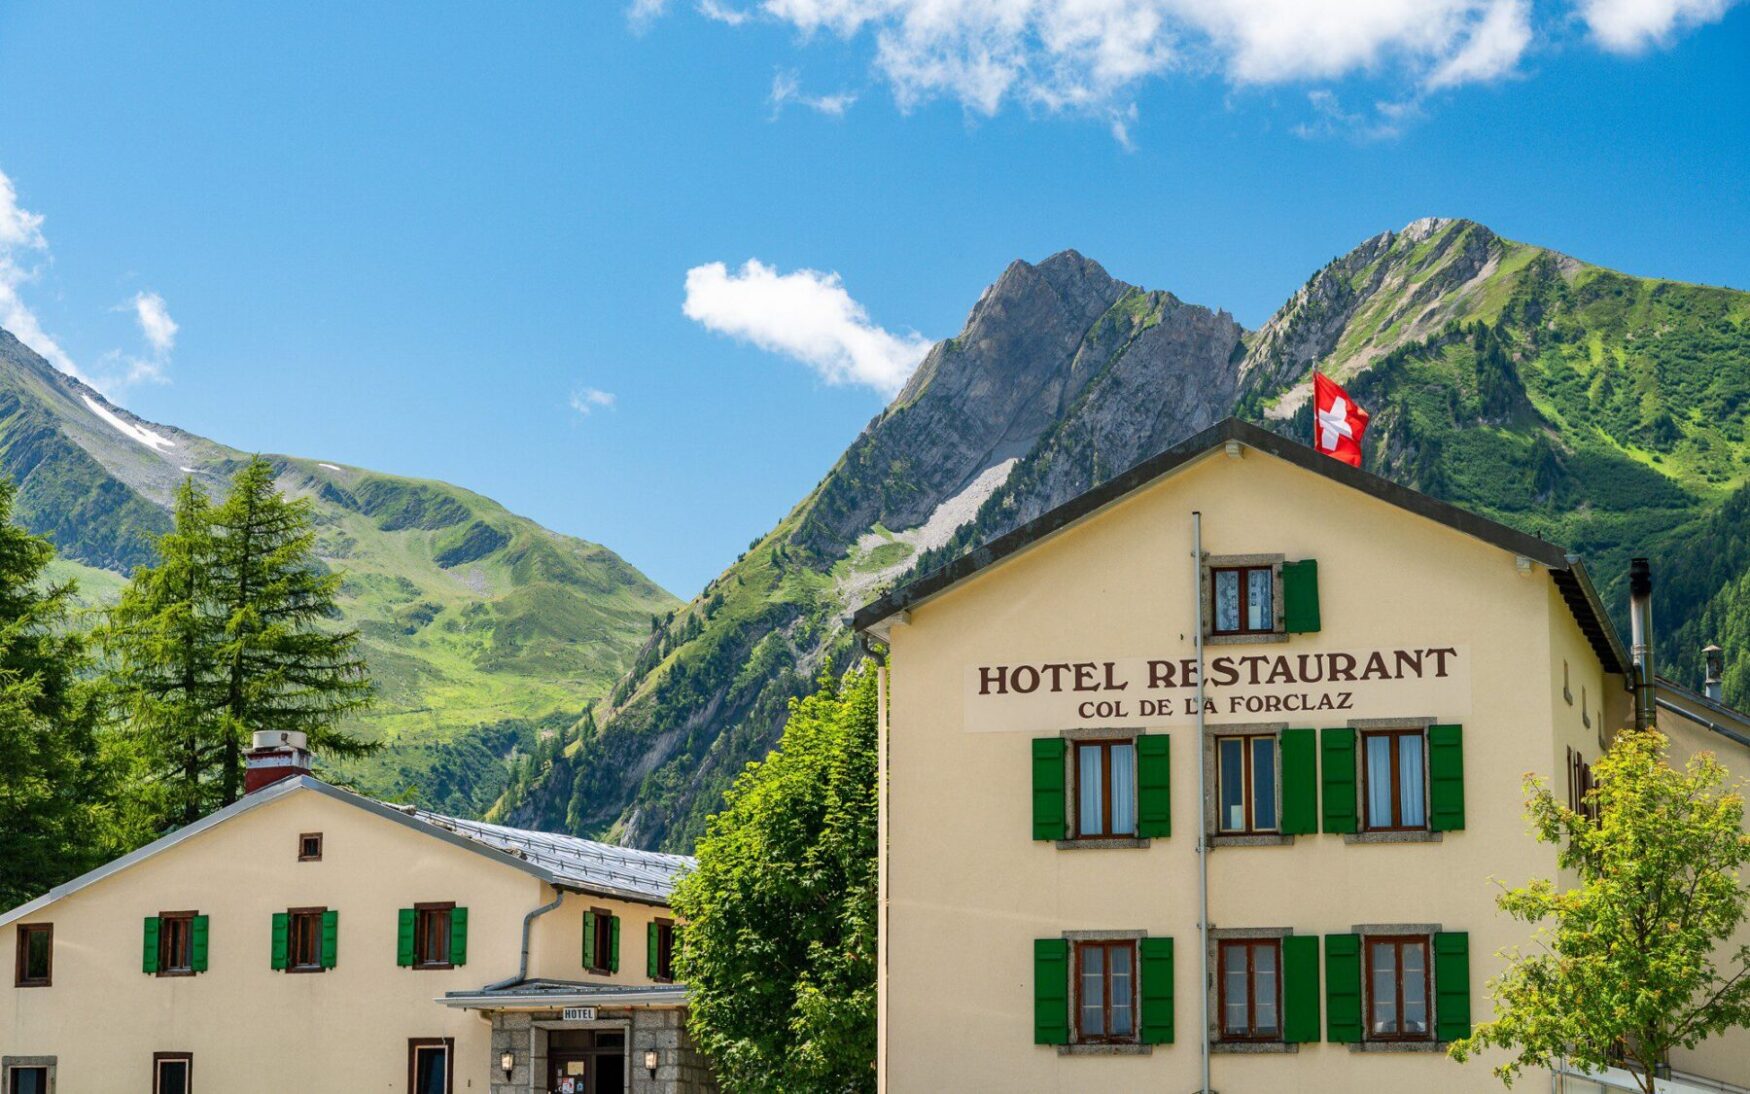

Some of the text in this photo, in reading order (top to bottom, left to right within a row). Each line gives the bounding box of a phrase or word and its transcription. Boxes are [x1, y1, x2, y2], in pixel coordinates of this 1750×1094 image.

[979, 648, 1457, 694] HOTEL RESTAURANT
[1078, 692, 1354, 718] COL DE LA FORCLAZ
[564, 1008, 593, 1019] HOTEL
